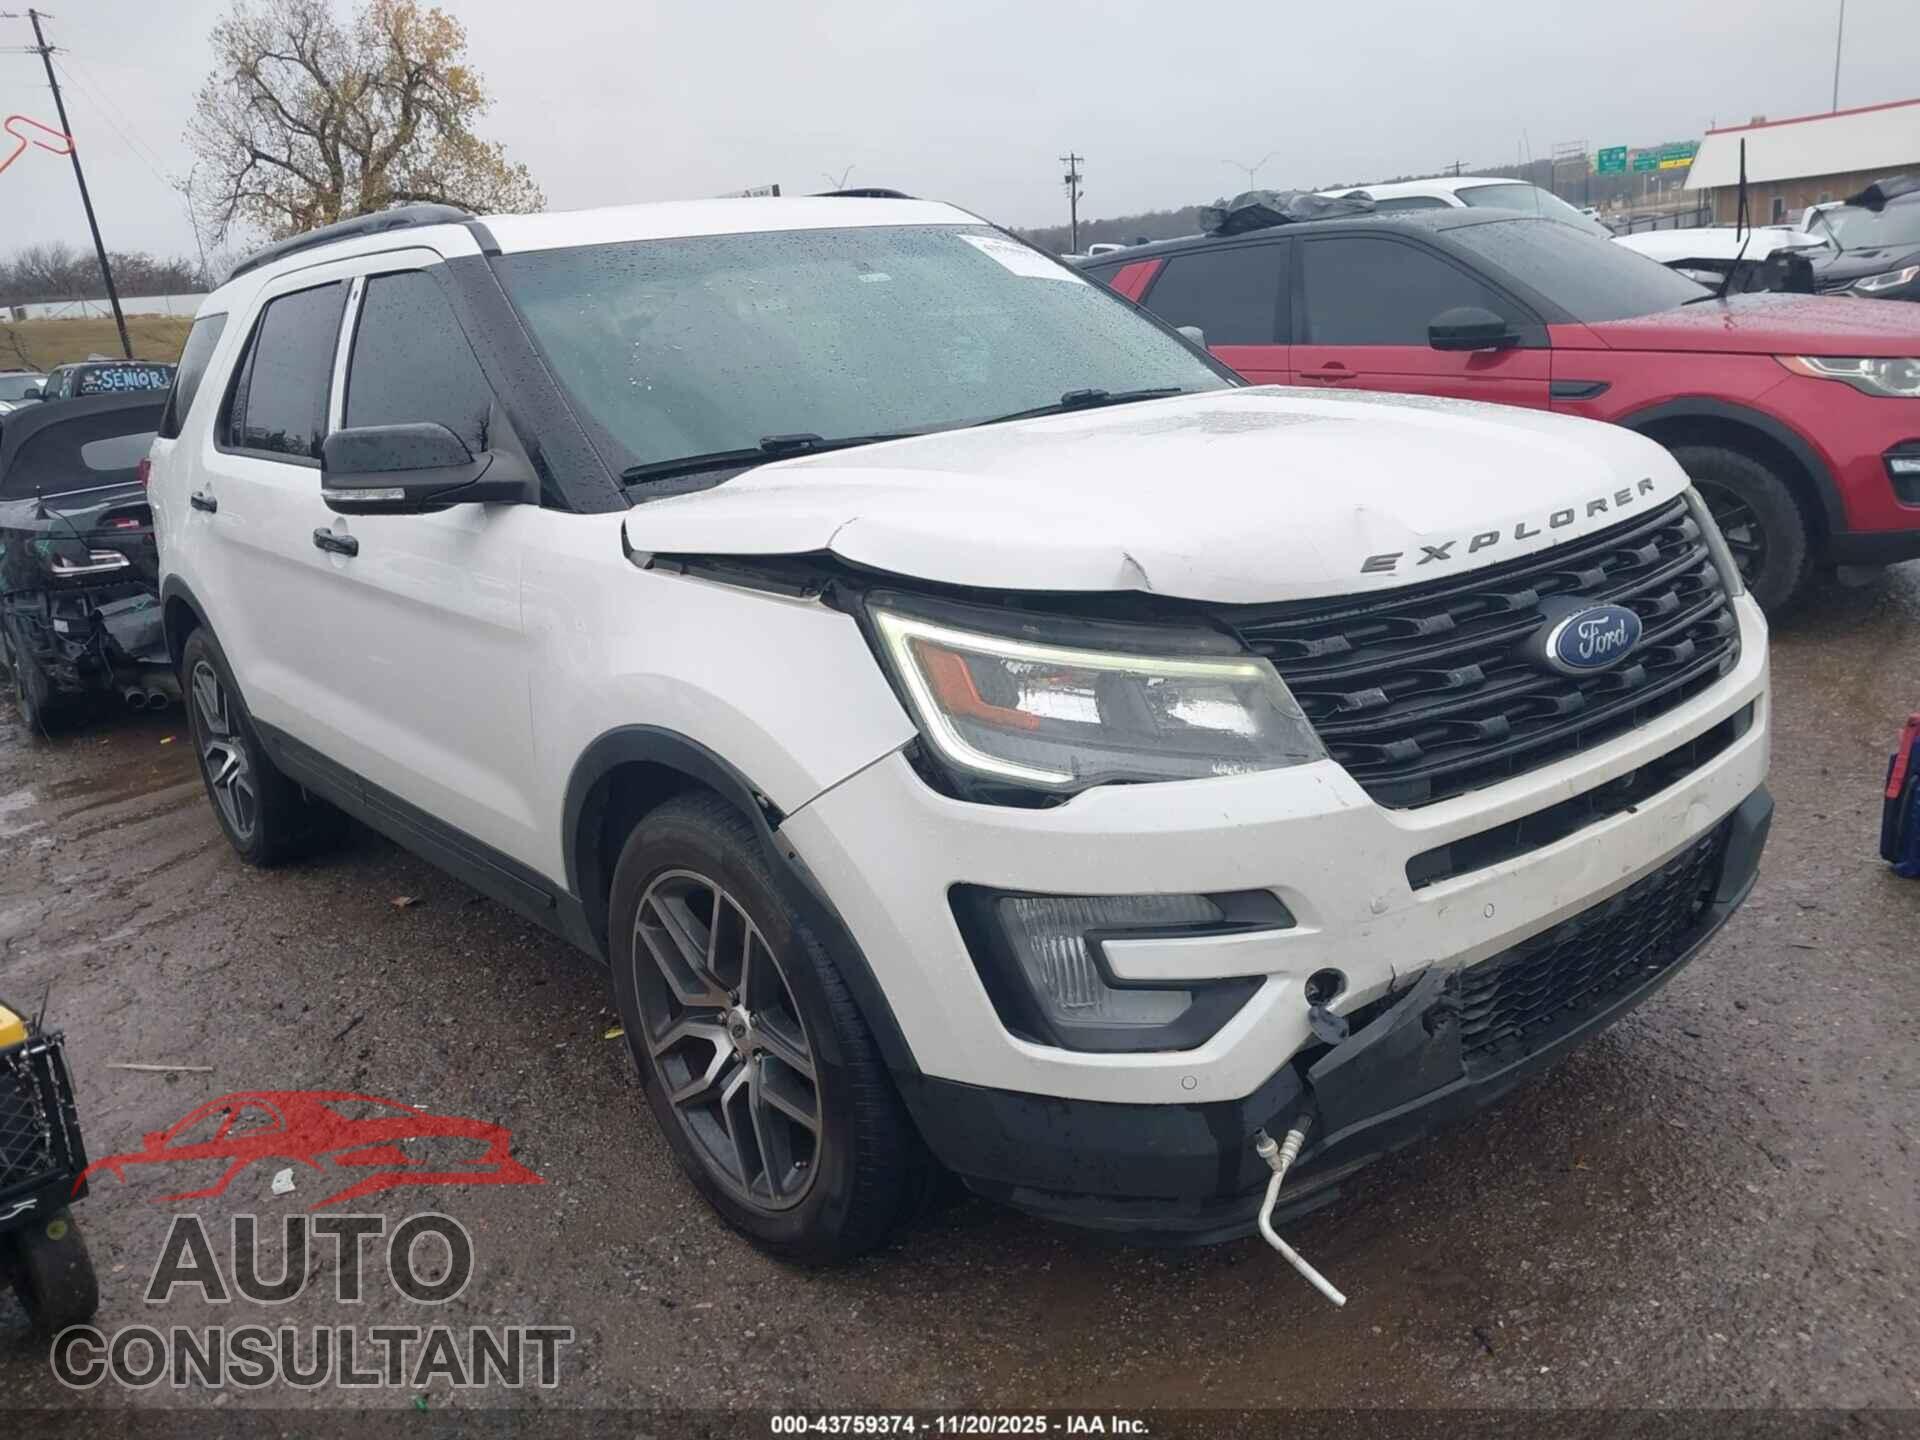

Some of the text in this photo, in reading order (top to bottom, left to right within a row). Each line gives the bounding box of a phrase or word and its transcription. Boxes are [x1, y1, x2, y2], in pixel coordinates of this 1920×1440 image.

[102, 370, 162, 388] SENIOR
[1360, 477, 1655, 573] EXPLORER
[1577, 616, 1629, 659] Ford
